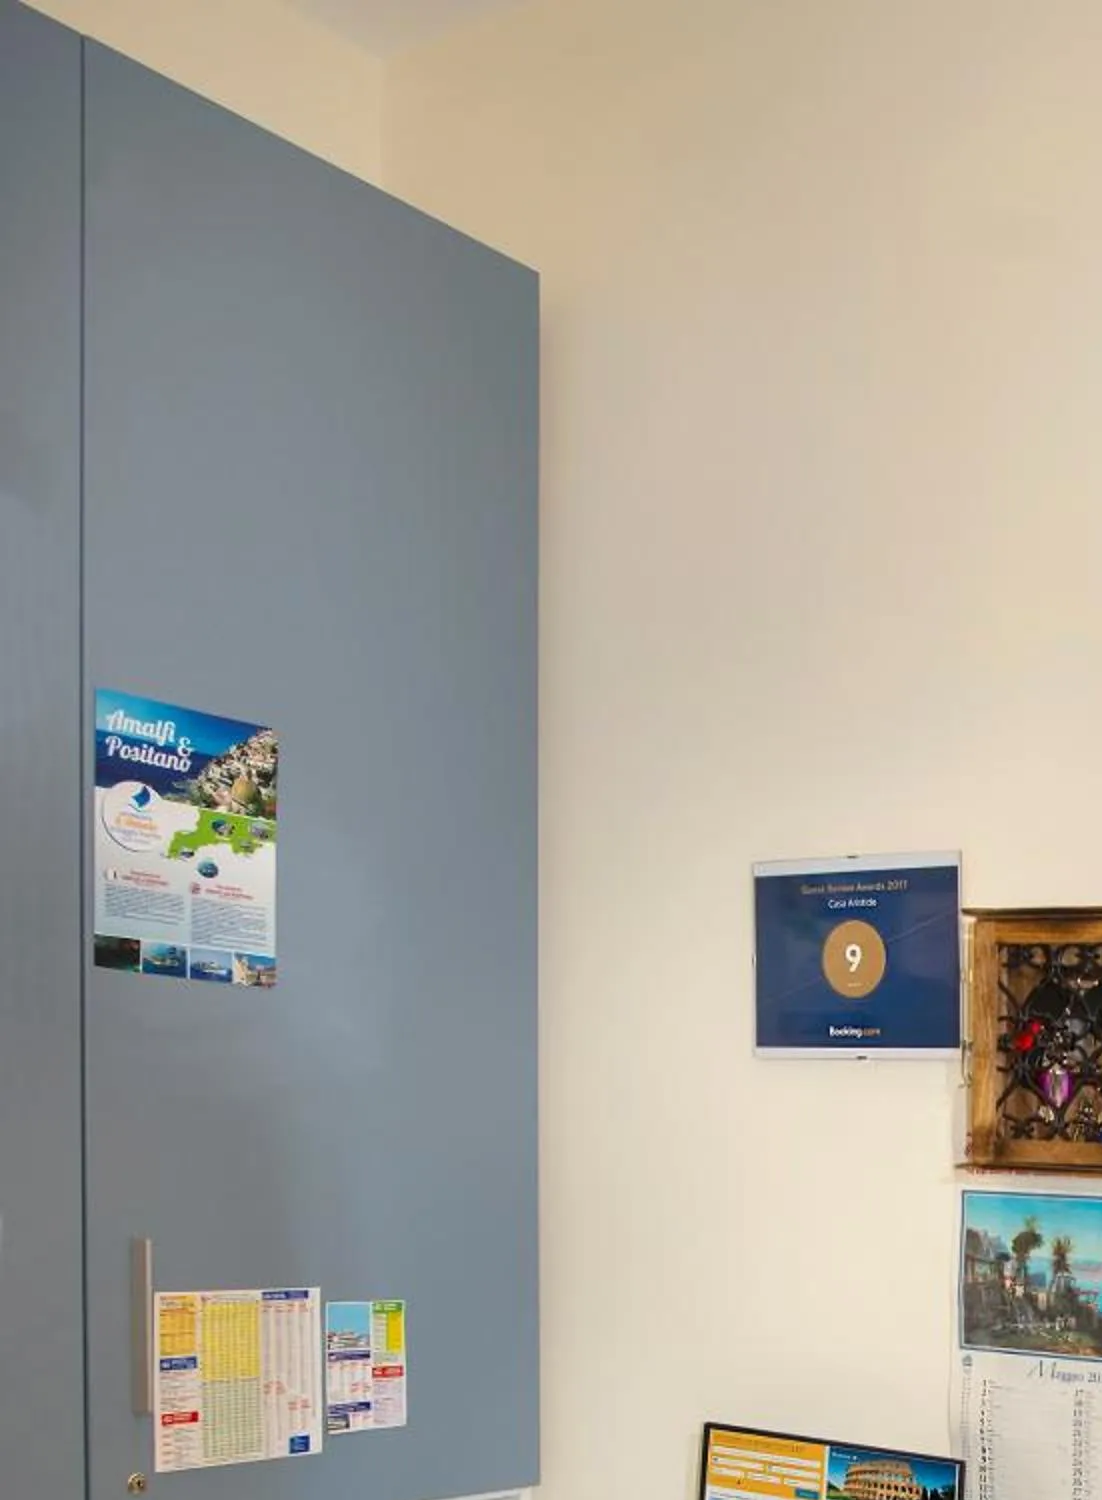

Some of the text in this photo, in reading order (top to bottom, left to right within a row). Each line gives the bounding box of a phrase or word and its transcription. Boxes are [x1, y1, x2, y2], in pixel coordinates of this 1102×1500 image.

[106, 709, 195, 757] Amalfi &
[105, 735, 192, 773] Positano
[845, 943, 862, 973] 9
